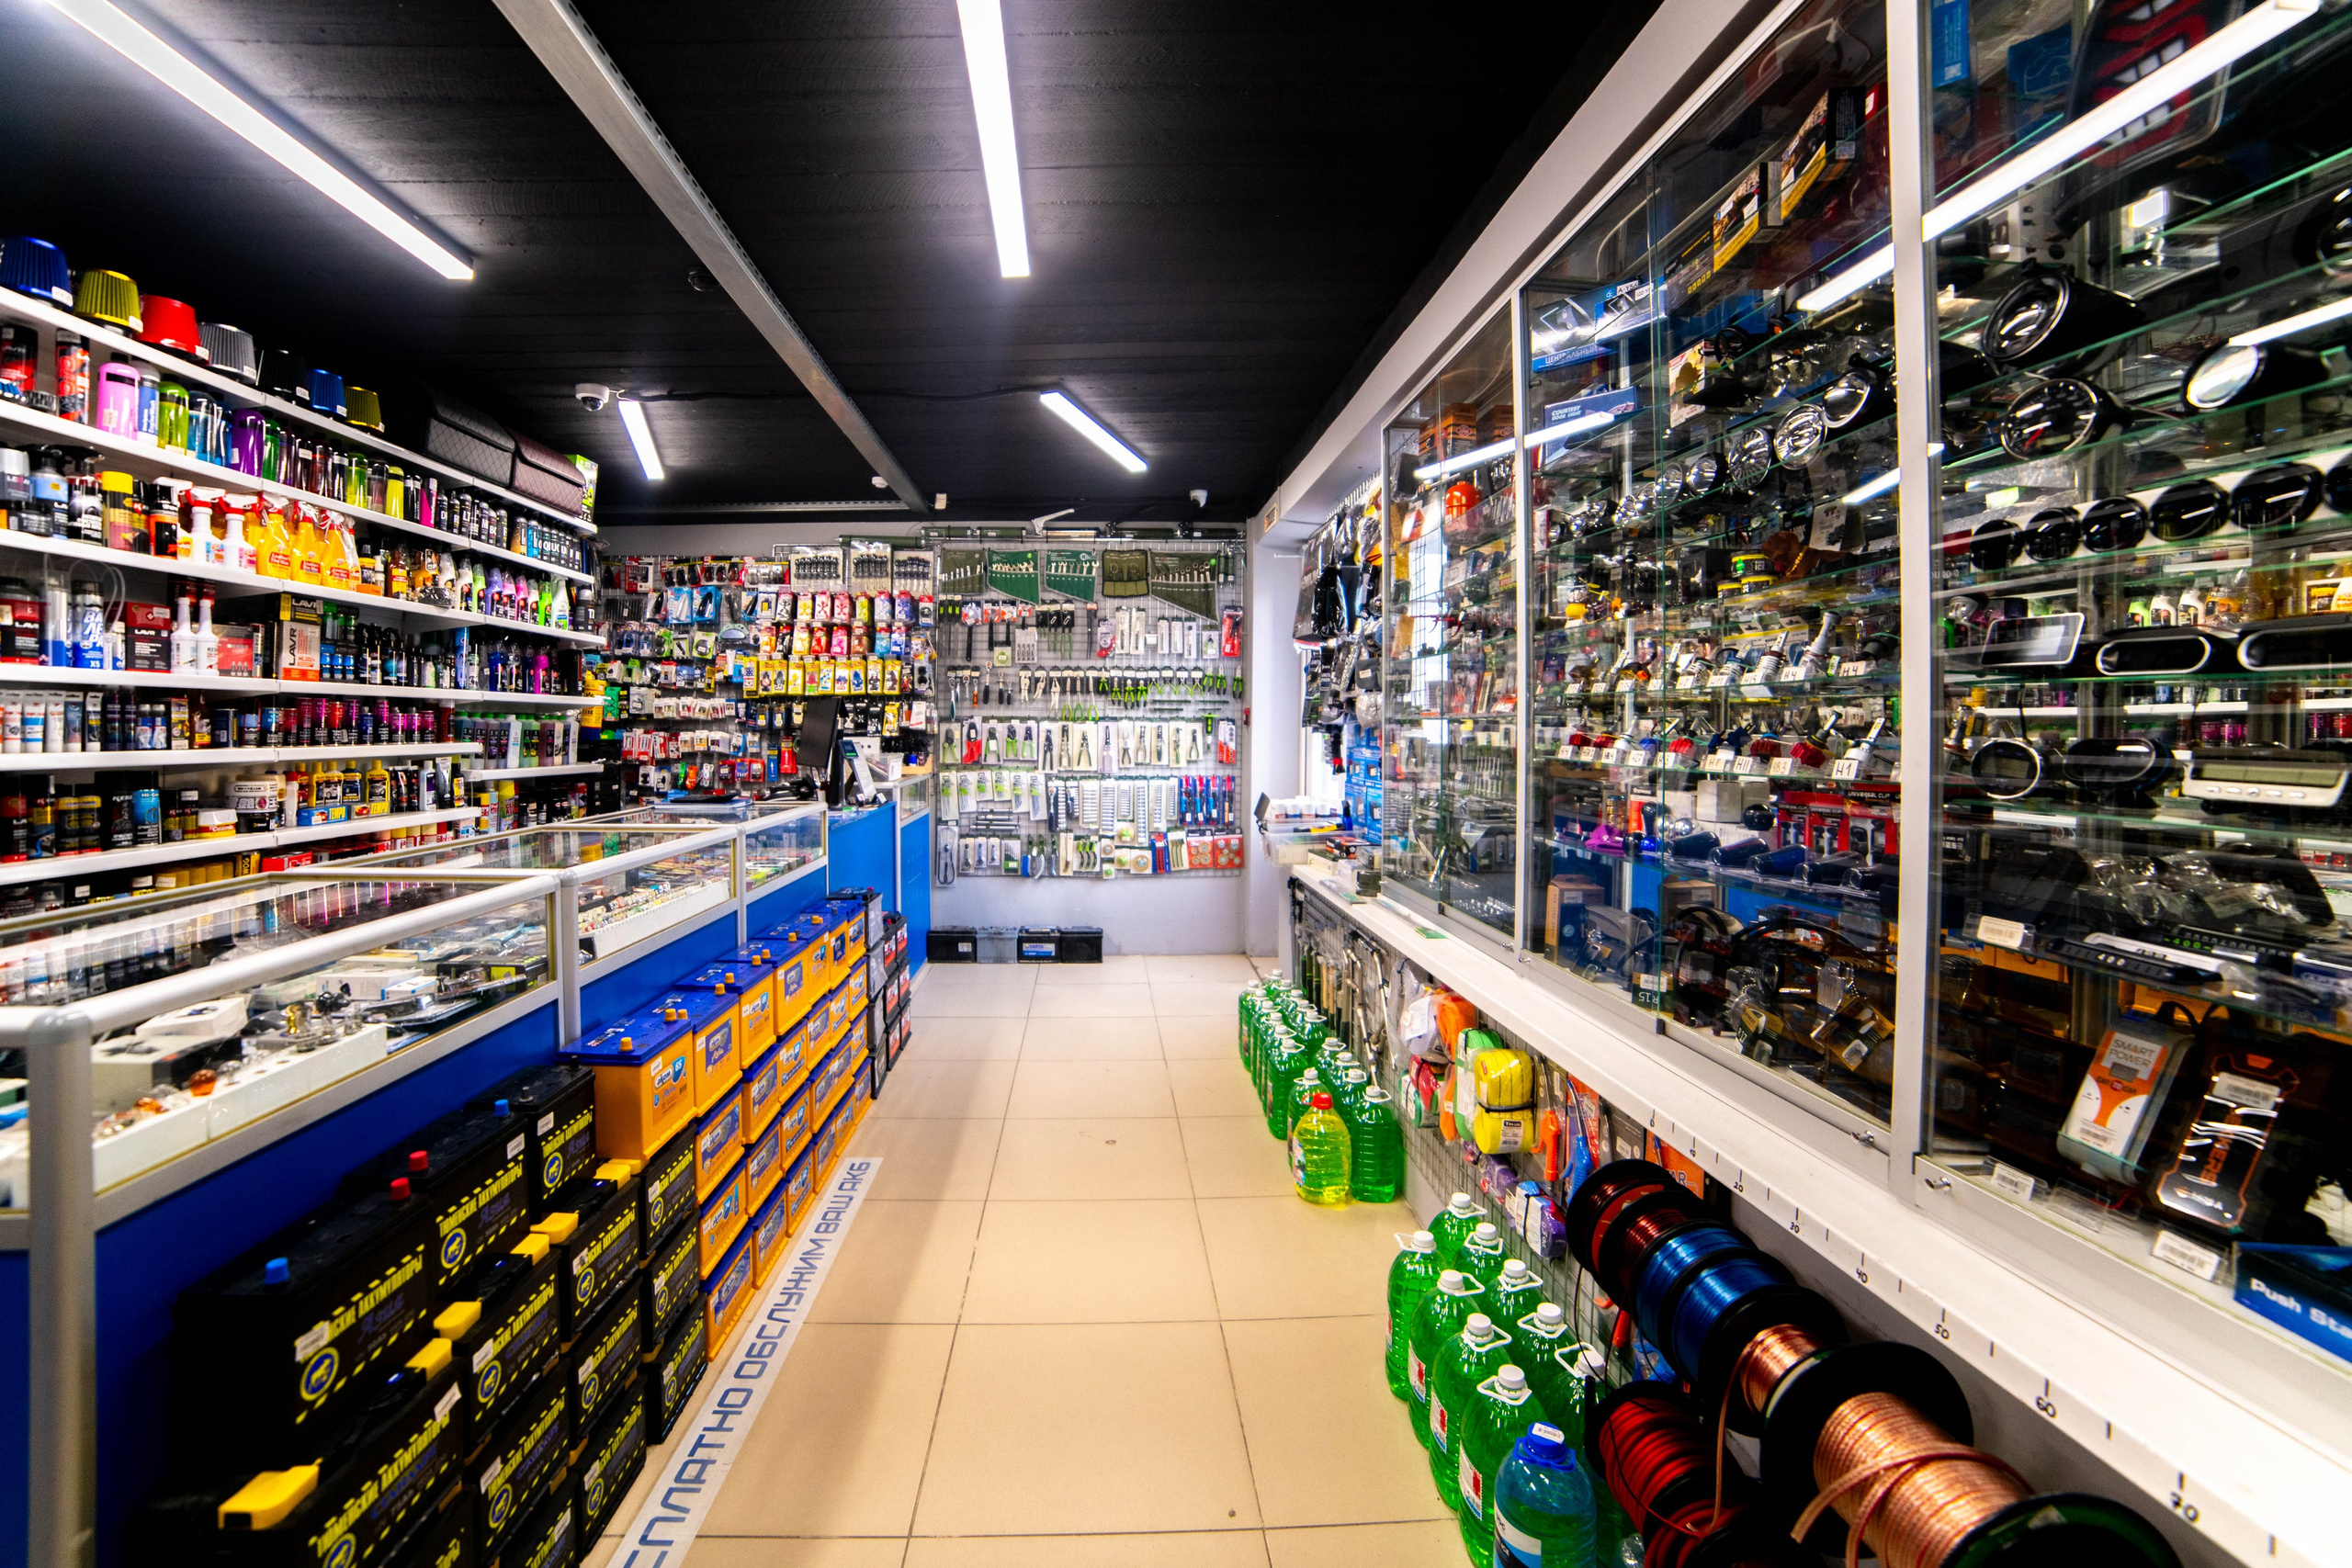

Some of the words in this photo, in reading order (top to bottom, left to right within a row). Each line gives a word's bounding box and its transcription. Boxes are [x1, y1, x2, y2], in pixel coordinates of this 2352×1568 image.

[1544, 344, 1598, 365] ЦЕНТРАЛЬНЫЙ
[1551, 405, 1582, 416] COURTESY
[288, 627, 298, 666] LAVR
[1842, 665, 1859, 677] H4
[1836, 762, 1852, 775] H1
[328, 806, 346, 820] TEMPO
[370, 801, 390, 815] TEMPO
[2112, 1038, 2155, 1057] SMART
[674, 1058, 683, 1072] 65
[2109, 1048, 2153, 1068] POWER
[1733, 1181, 1744, 1193] 20
[1789, 1221, 1801, 1234] 30
[734, 1237, 832, 1379] ОБСЛУЖИМ
[813, 1193, 854, 1234] ВАШ
[838, 1160, 872, 1193] АКБ
[1855, 1268, 1869, 1284] 40
[2250, 1277, 2301, 1314] Push
[1934, 1324, 1951, 1340] 50
[2035, 1395, 2057, 1419] 60
[2169, 1490, 2200, 1524] 70
